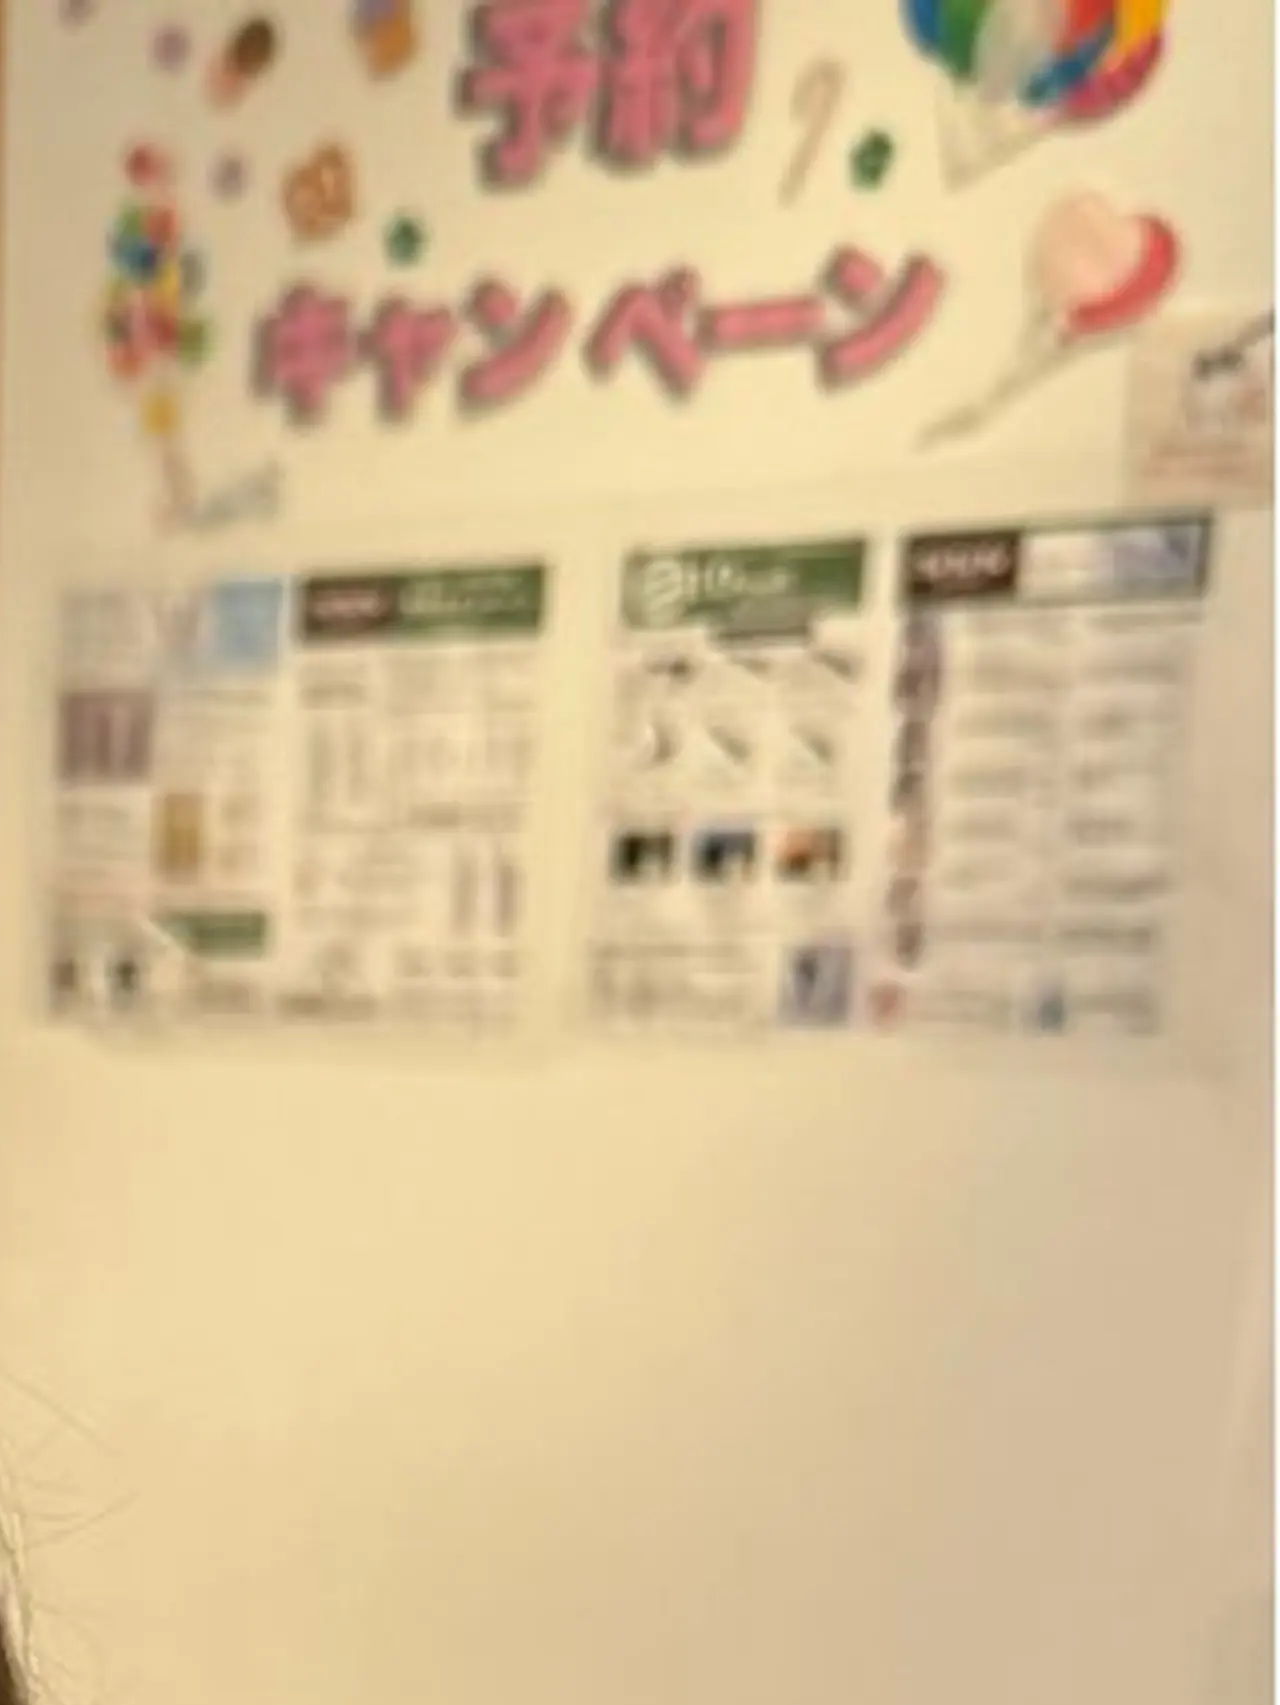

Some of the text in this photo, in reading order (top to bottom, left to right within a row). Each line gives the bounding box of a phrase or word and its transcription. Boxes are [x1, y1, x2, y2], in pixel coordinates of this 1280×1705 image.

[458, 0, 758, 188] 予約
[255, 247, 943, 424] キャンペーン
